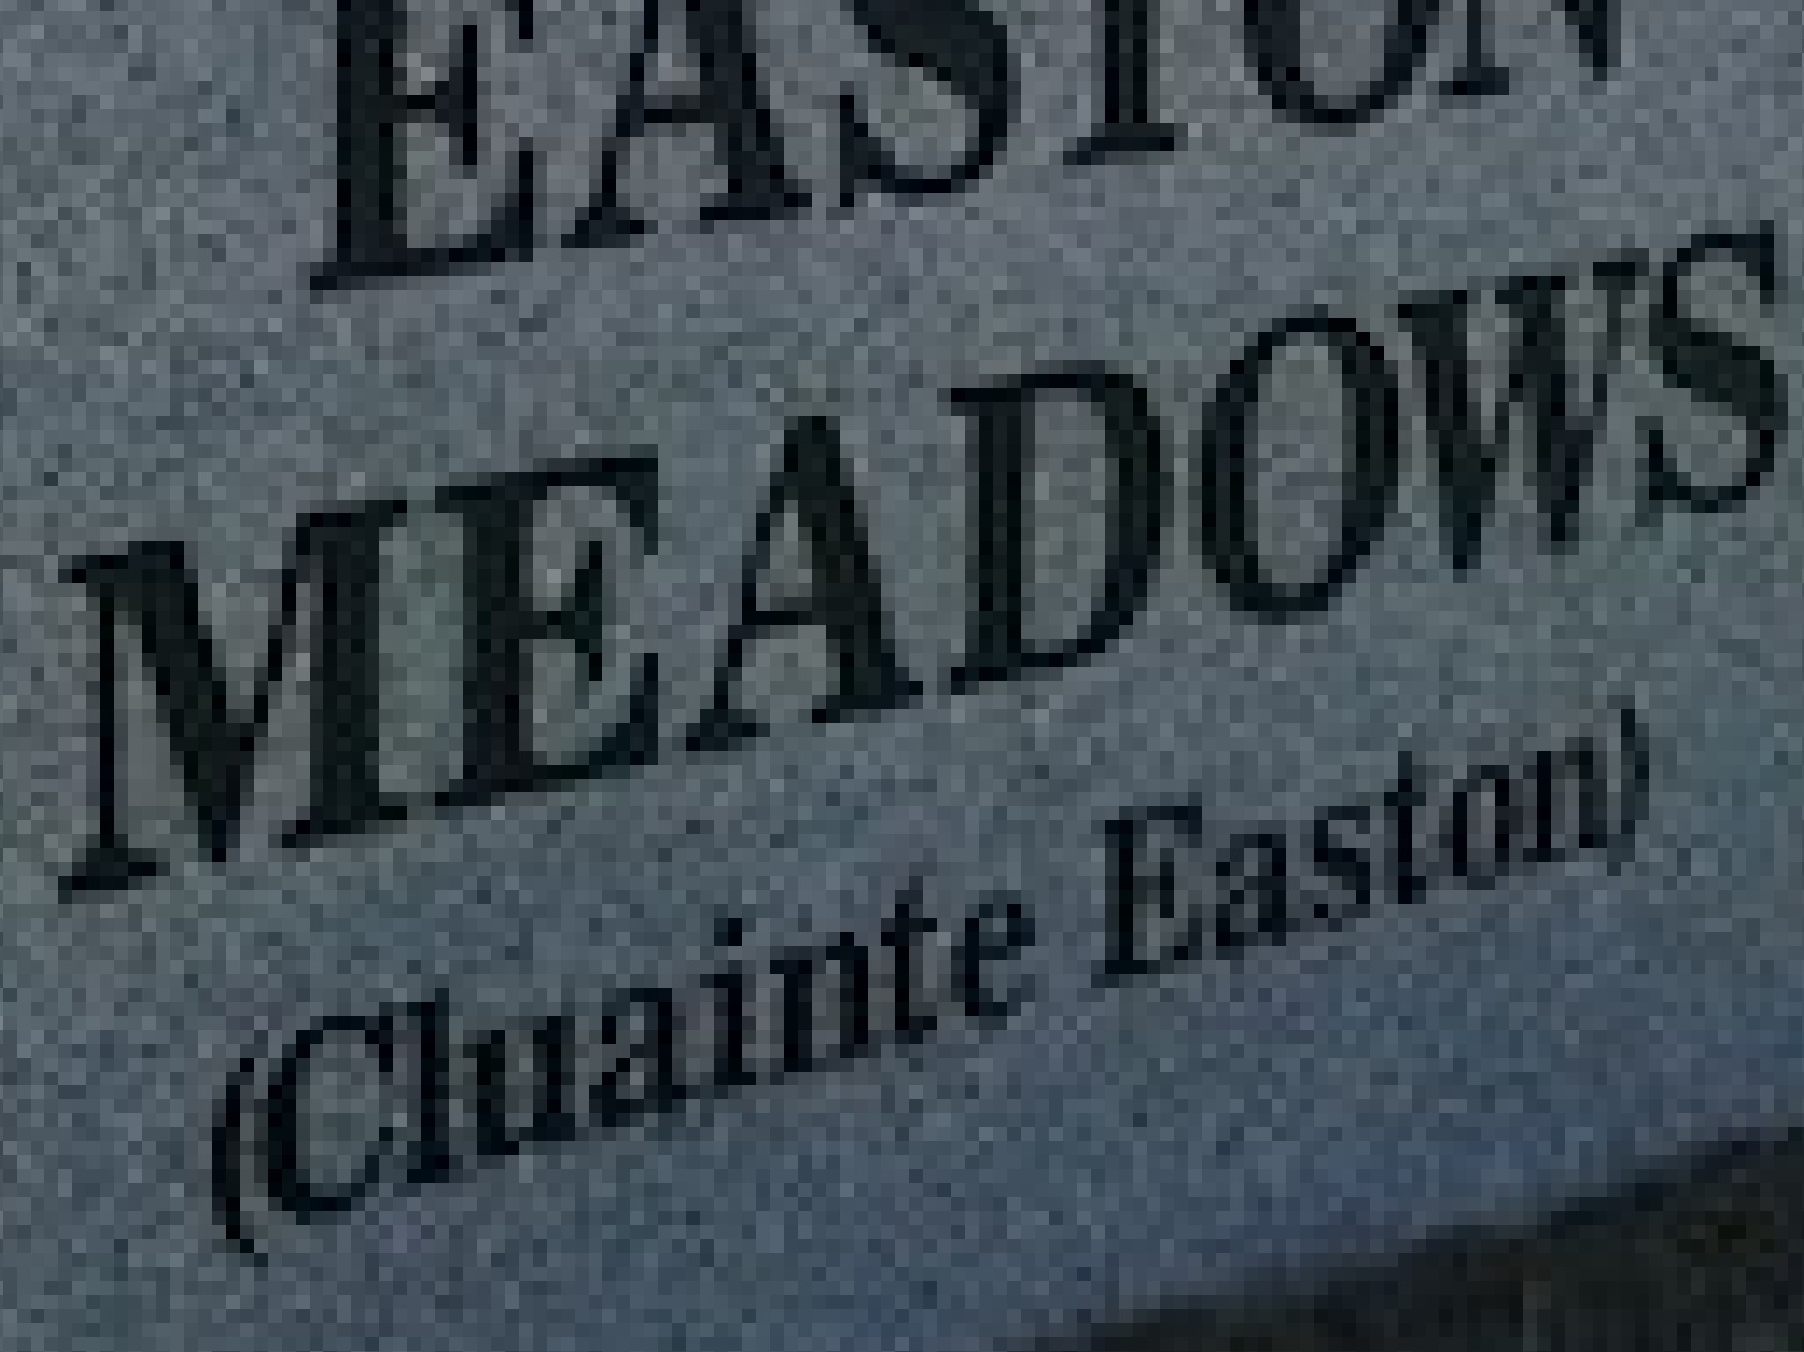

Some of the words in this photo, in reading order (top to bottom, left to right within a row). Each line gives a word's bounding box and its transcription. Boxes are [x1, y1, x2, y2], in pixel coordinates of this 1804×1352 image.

[55, 221, 1790, 907] MEADOWS
[207, 869, 1039, 1262] (Cluainte
[1089, 697, 1653, 992] Easton)
